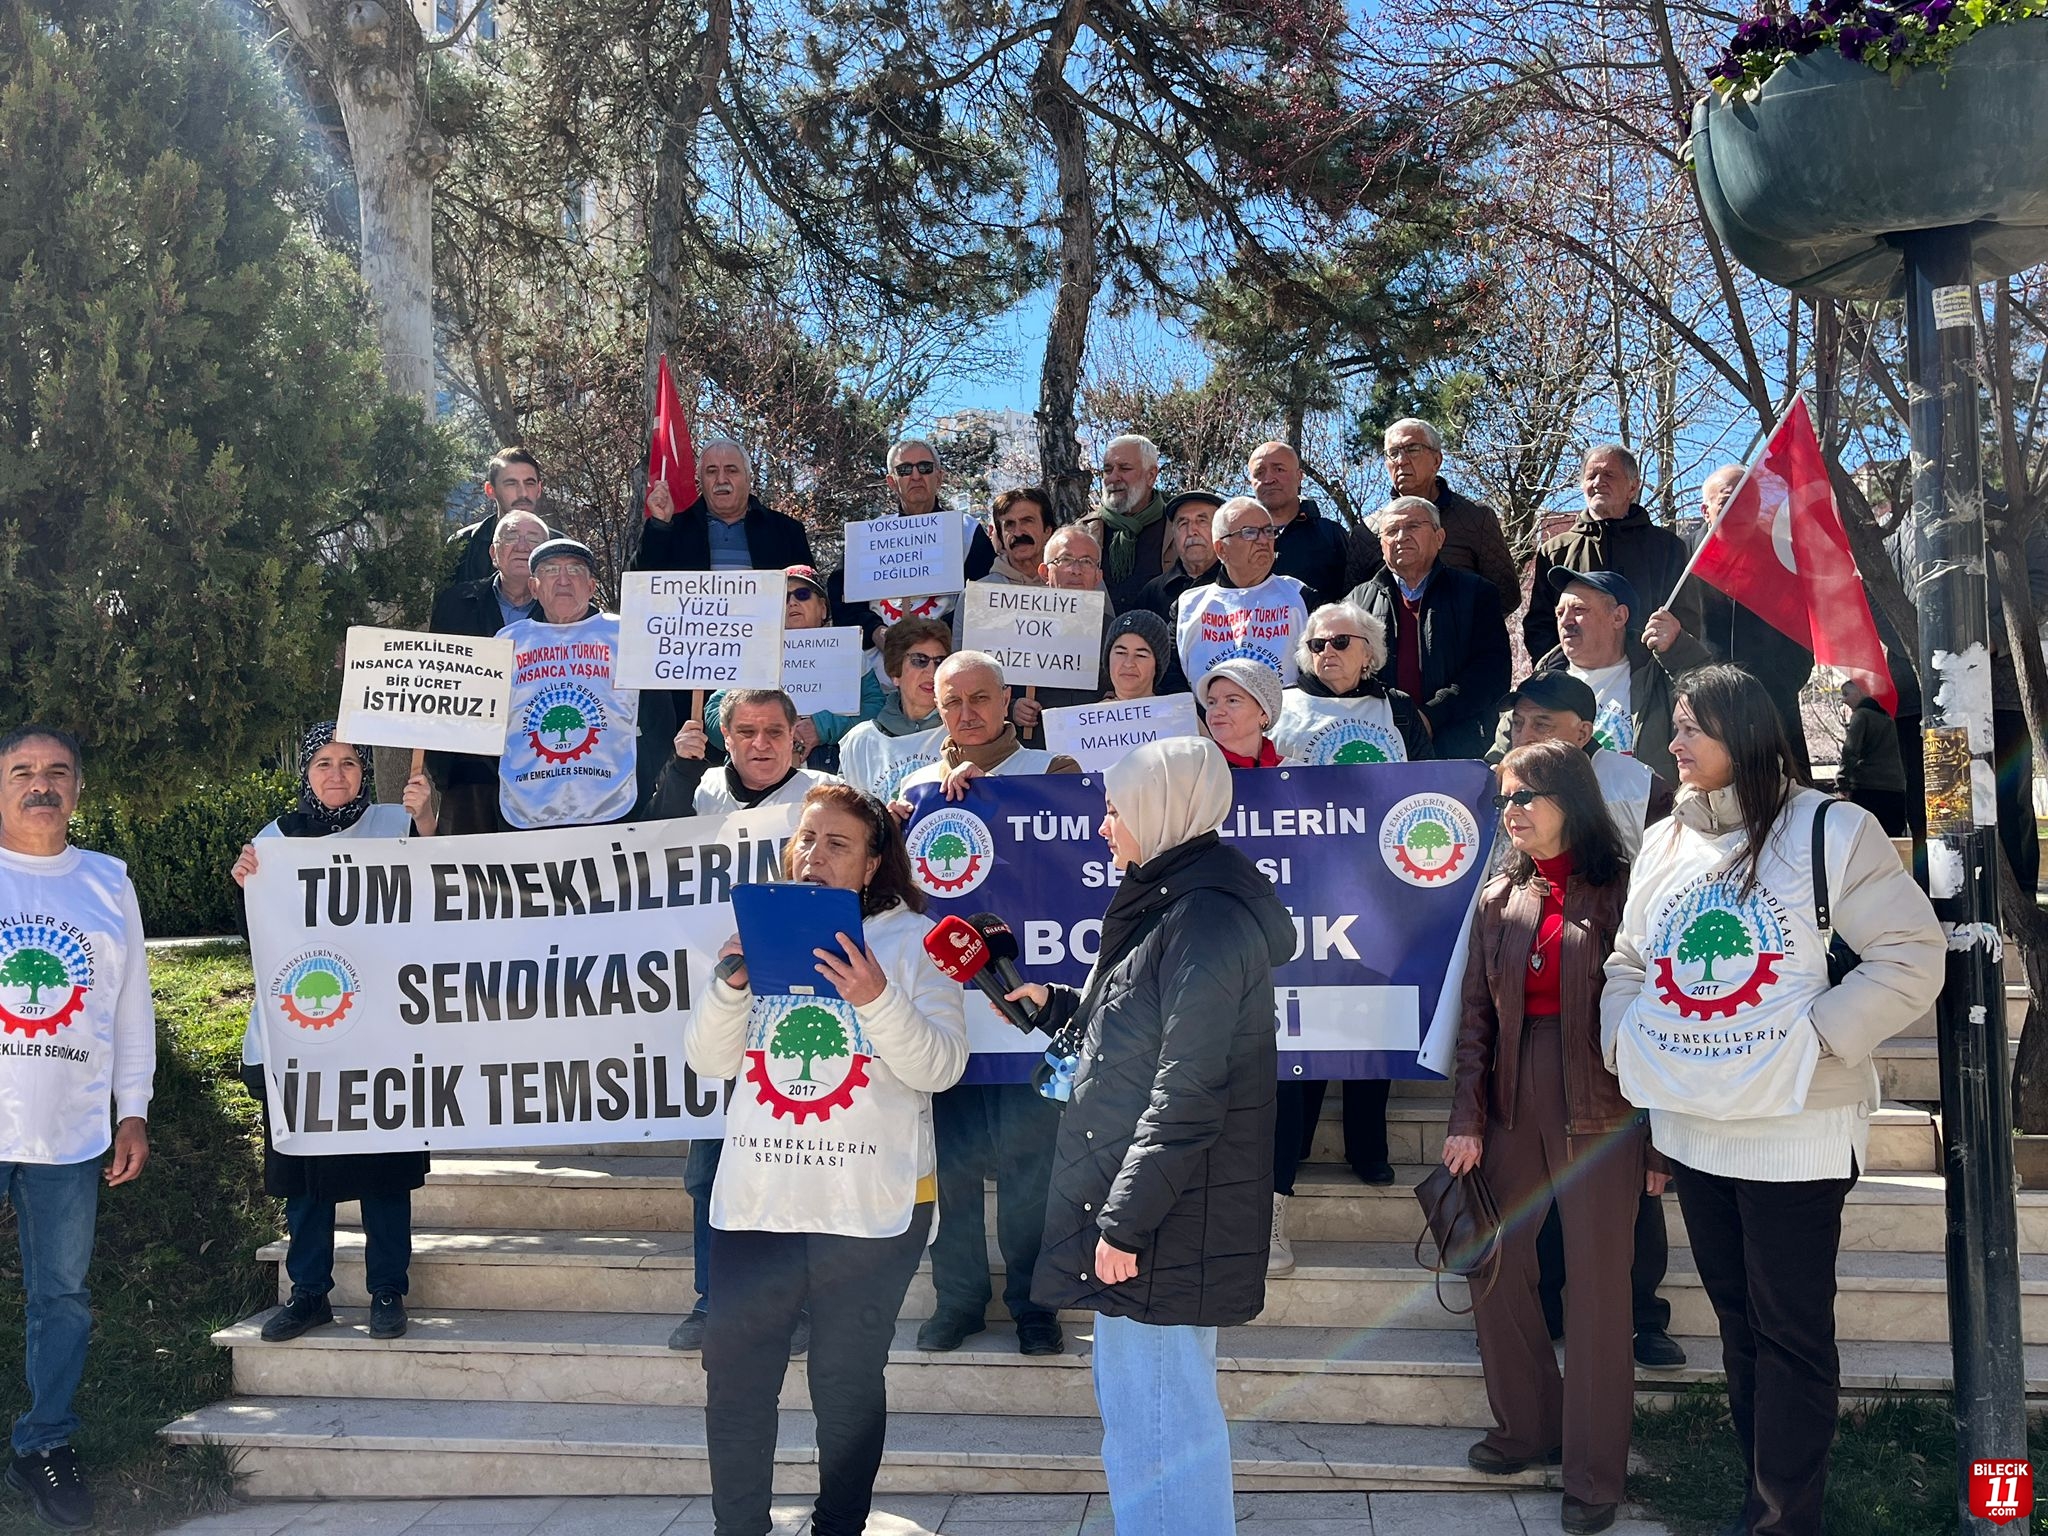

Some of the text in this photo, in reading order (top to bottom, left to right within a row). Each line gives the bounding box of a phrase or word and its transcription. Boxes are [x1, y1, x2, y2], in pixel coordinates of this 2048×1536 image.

[868, 516, 938, 533] YOKSULLUK
[870, 532, 937, 550] EMEKLİNİN
[879, 551, 923, 566] KADERİ
[873, 565, 930, 581] DEĞİLDİR
[650, 575, 757, 595] Emeklinin
[678, 597, 729, 617] Yüzü
[989, 592, 1078, 613] EMEKLİYE
[1201, 604, 1290, 628] DEMOKRATİK TÜRKİYE
[647, 616, 753, 638] Gülmezse
[1015, 619, 1053, 638] YOK
[1201, 623, 1290, 642] İNSANCA YAŞAM
[384, 639, 473, 657] EMEKLİLERE
[658, 637, 741, 660] Bayram
[783, 638, 839, 649] NLARIMIZI
[516, 640, 610, 670] DEMOKRATİK TÜRKİYE
[782, 659, 816, 669] RMEK
[1037, 653, 1081, 671] VAR!
[351, 659, 504, 680] İNSANCA YAŞANACAK
[515, 663, 610, 685] İNSANCA YAŞAM
[655, 659, 737, 681] Gelmez
[386, 674, 462, 691] BİR ÜCRET
[781, 683, 822, 693] YORUZ!
[363, 686, 483, 717] İSTİYORUZ
[525, 682, 573, 714] EMEKLİLER
[576, 684, 608, 731] SENDİKASI
[1079, 705, 1152, 726] SEFALETE
[555, 742, 572, 750] 2017
[1081, 731, 1157, 750] MAHKUM
[530, 766, 572, 781] EMEKLİLER
[573, 766, 612, 779] SENDİKASI
[1007, 810, 1090, 842] TÜM
[298, 828, 791, 928] TÜM EMEKLİLERİN
[0, 912, 95, 991] KLİLER SENDİKASI
[959, 938, 982, 964] anka
[271, 949, 361, 997] TÜM EMEKLİLERİN SENDİKASI
[399, 944, 691, 1026] SENDİKASI
[1691, 985, 1719, 996] 2017
[19, 1005, 46, 1016] 2017
[1637, 1023, 1788, 1044] TÜM EMEKLİLERİN
[0, 1040, 42, 1057] KLİLER
[1658, 1043, 1752, 1057] SENDİKASI
[277, 1053, 465, 1133] İLECİK
[788, 1084, 816, 1097] 2017
[732, 1136, 878, 1155] TÜM EMEKLİLERİN
[755, 1151, 844, 1167] SENDİKASI
